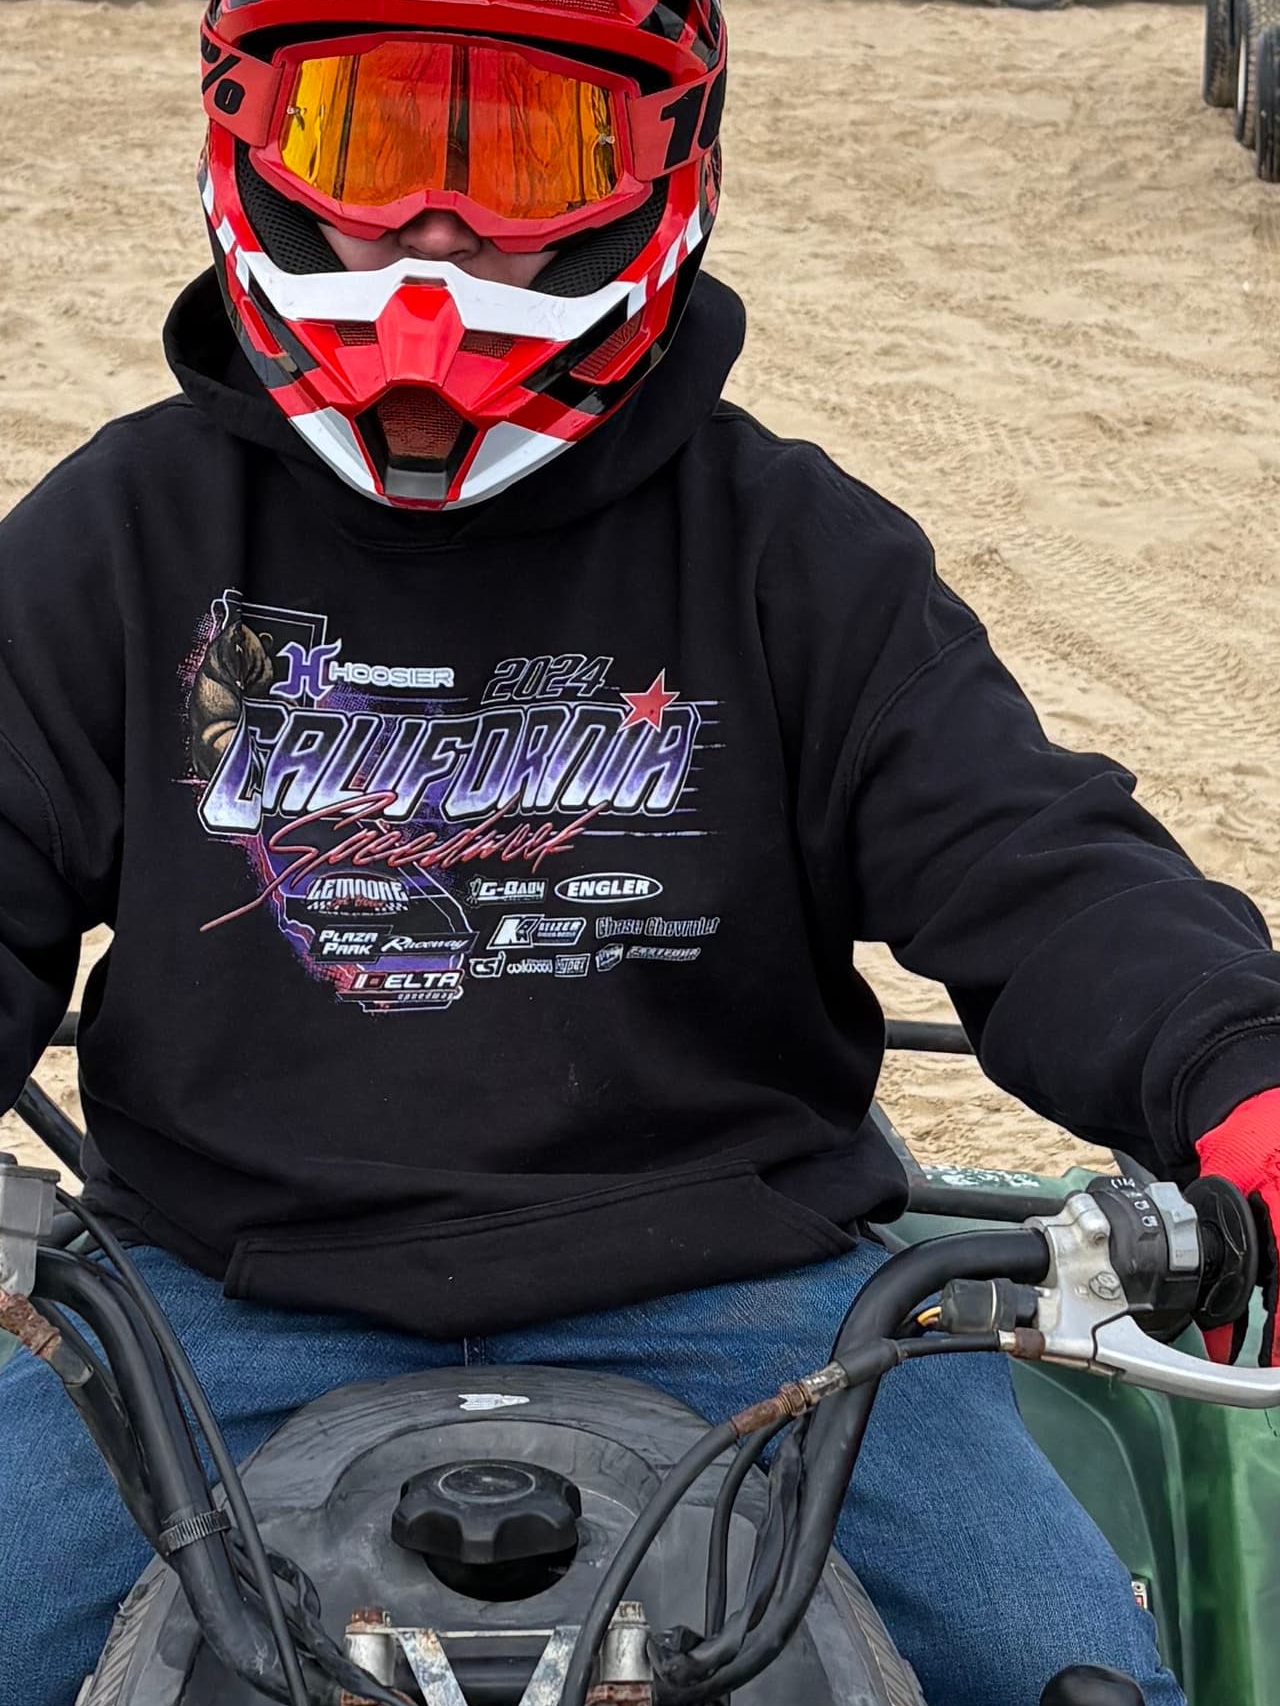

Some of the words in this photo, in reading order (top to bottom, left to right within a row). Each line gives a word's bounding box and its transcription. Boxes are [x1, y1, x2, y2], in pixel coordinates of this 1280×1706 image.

[328, 660, 455, 689] HOOSIER
[481, 654, 614, 704] 2024
[198, 697, 701, 836] CALIFORNIA
[306, 878, 410, 902] LEMOORE
[568, 880, 651, 897] ENGLER
[319, 929, 379, 943] PLAZA
[380, 935, 469, 951] Raceway
[322, 942, 374, 956] PARK
